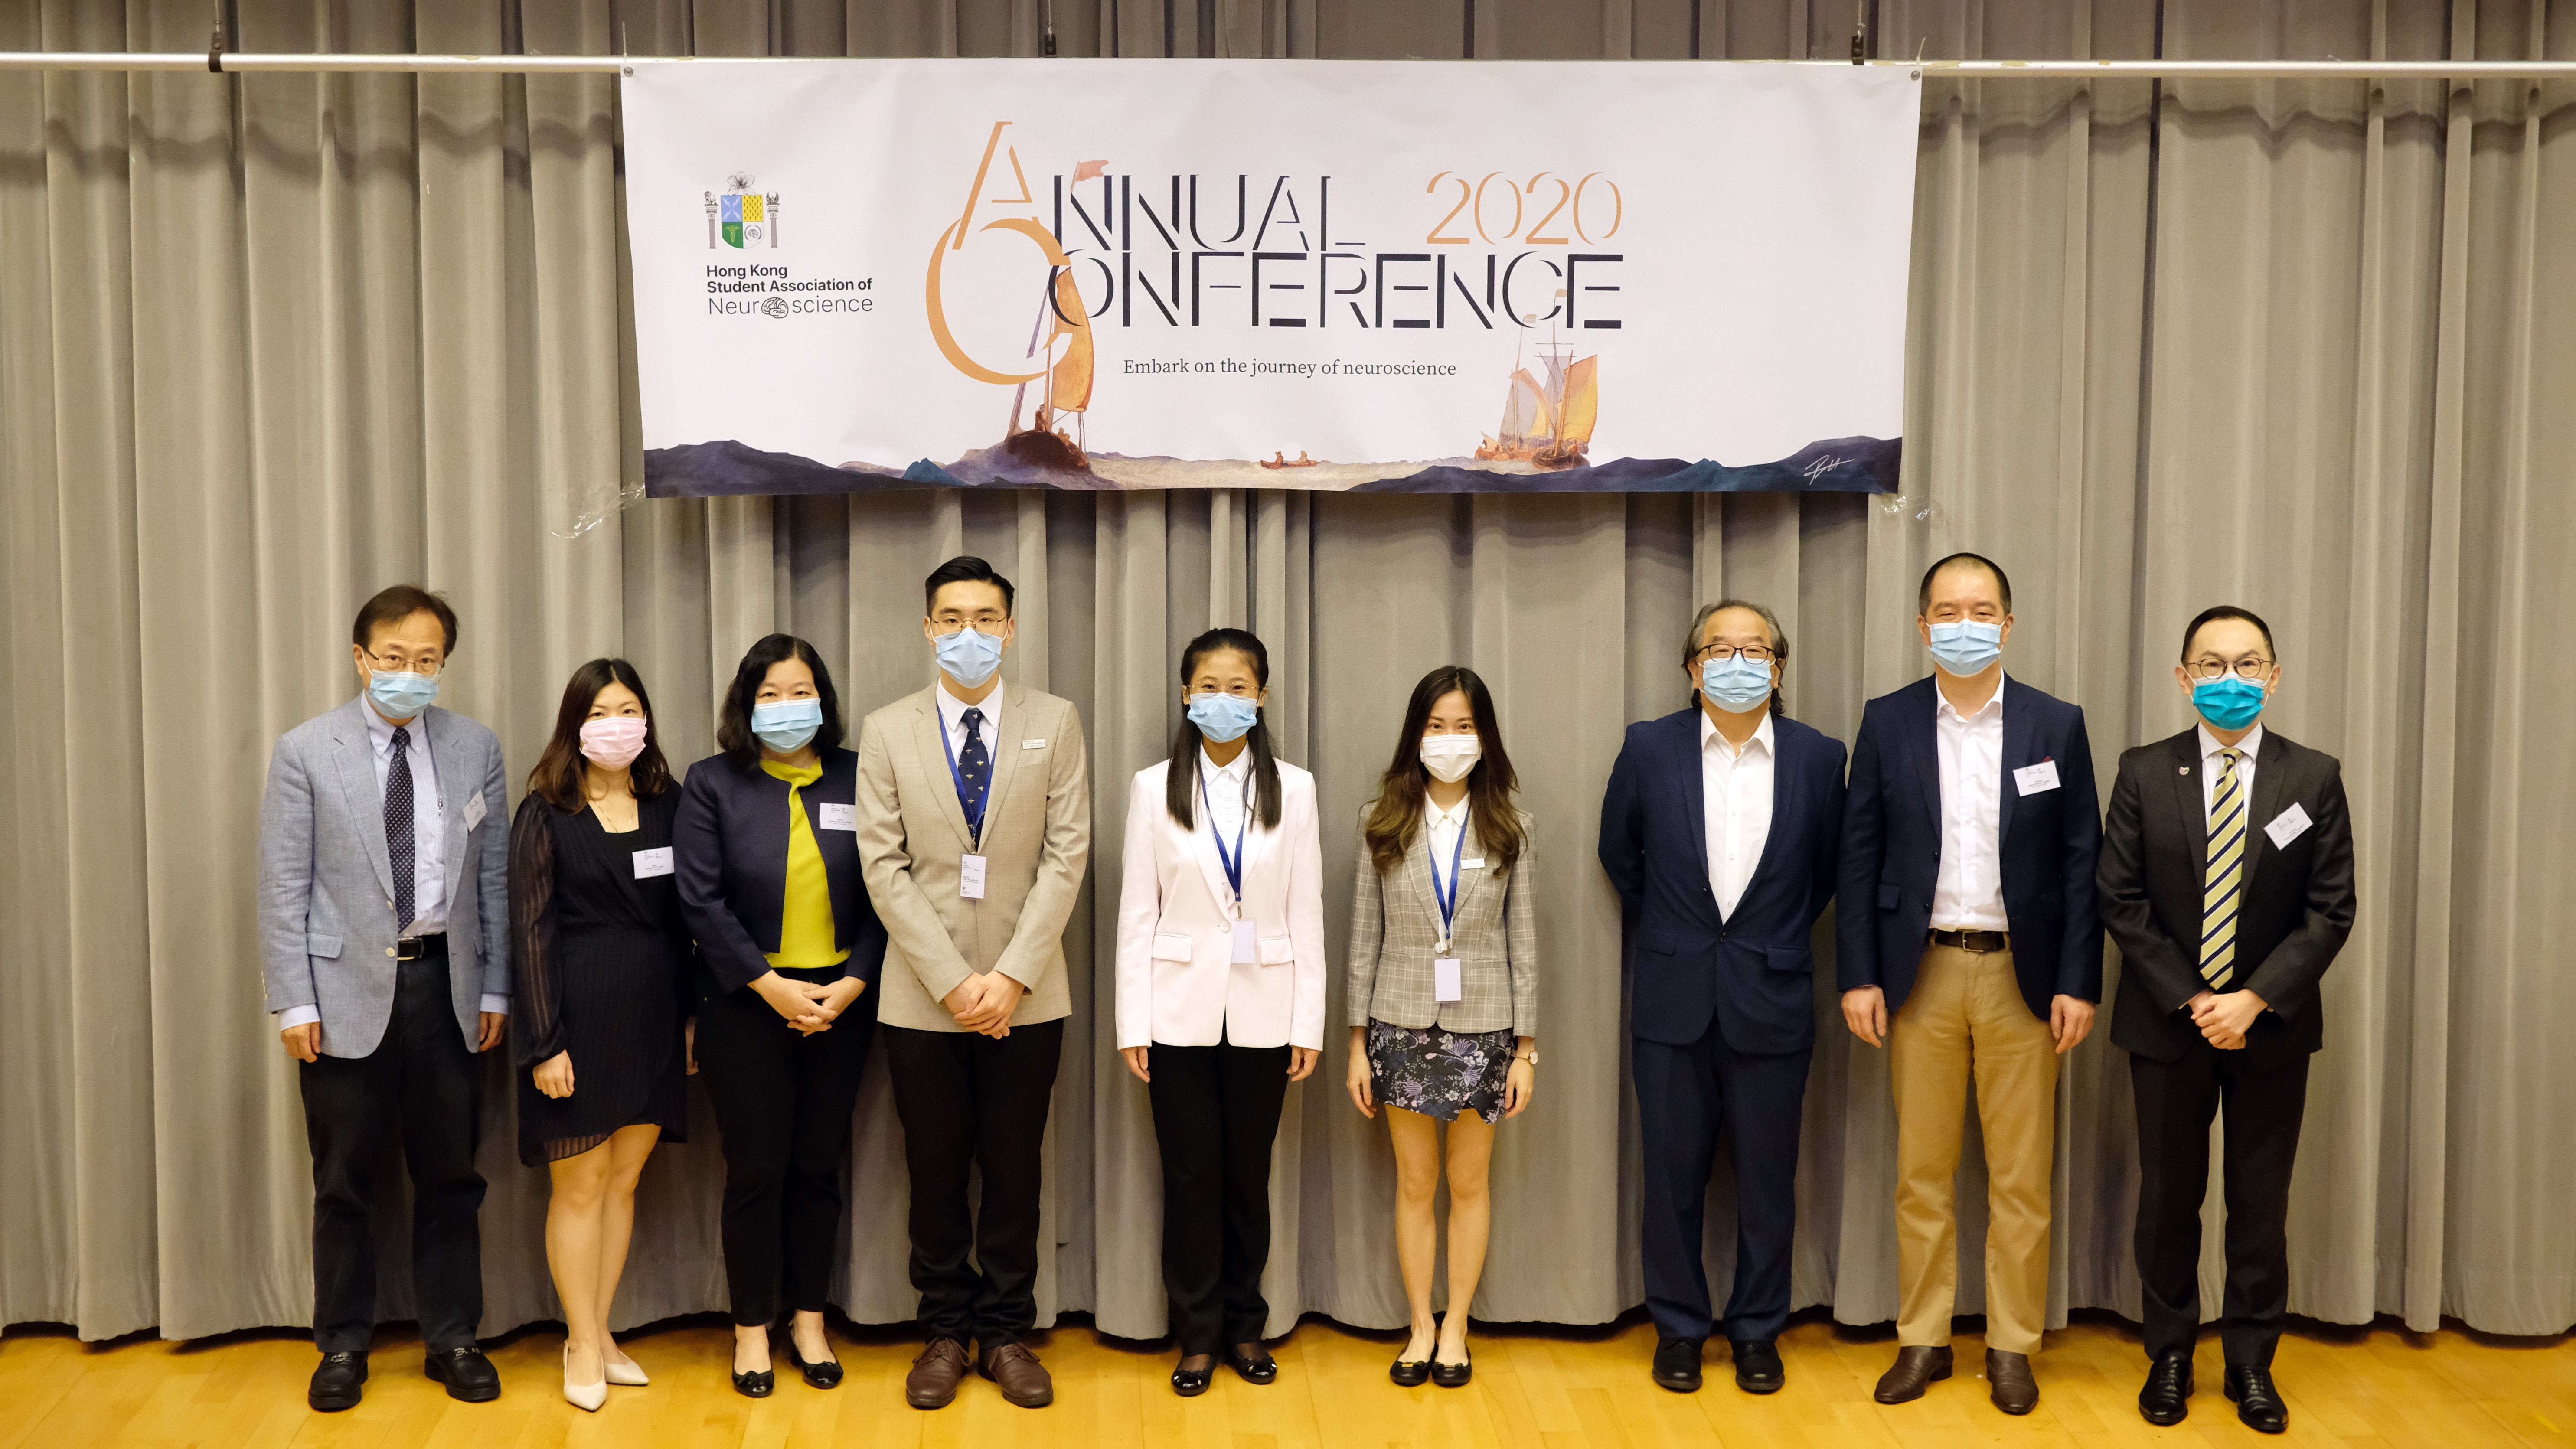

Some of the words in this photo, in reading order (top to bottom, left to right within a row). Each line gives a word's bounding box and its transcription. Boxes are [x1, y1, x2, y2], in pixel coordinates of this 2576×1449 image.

[952, 121, 1366, 250] ANNUAL
[1426, 171, 1622, 245] 2020
[707, 265, 746, 280] Hong
[750, 264, 787, 279] Kong
[707, 281, 766, 293] Student
[769, 278, 854, 292] Association
[858, 278, 872, 290] of
[926, 218, 1623, 385] CONFERENCE
[1123, 358, 1190, 374] Embark
[1194, 362, 1215, 373] on
[1220, 358, 1247, 373] the
[1250, 358, 1317, 379] journey
[1322, 359, 1341, 375] of
[1343, 360, 1456, 376] neuroscience
